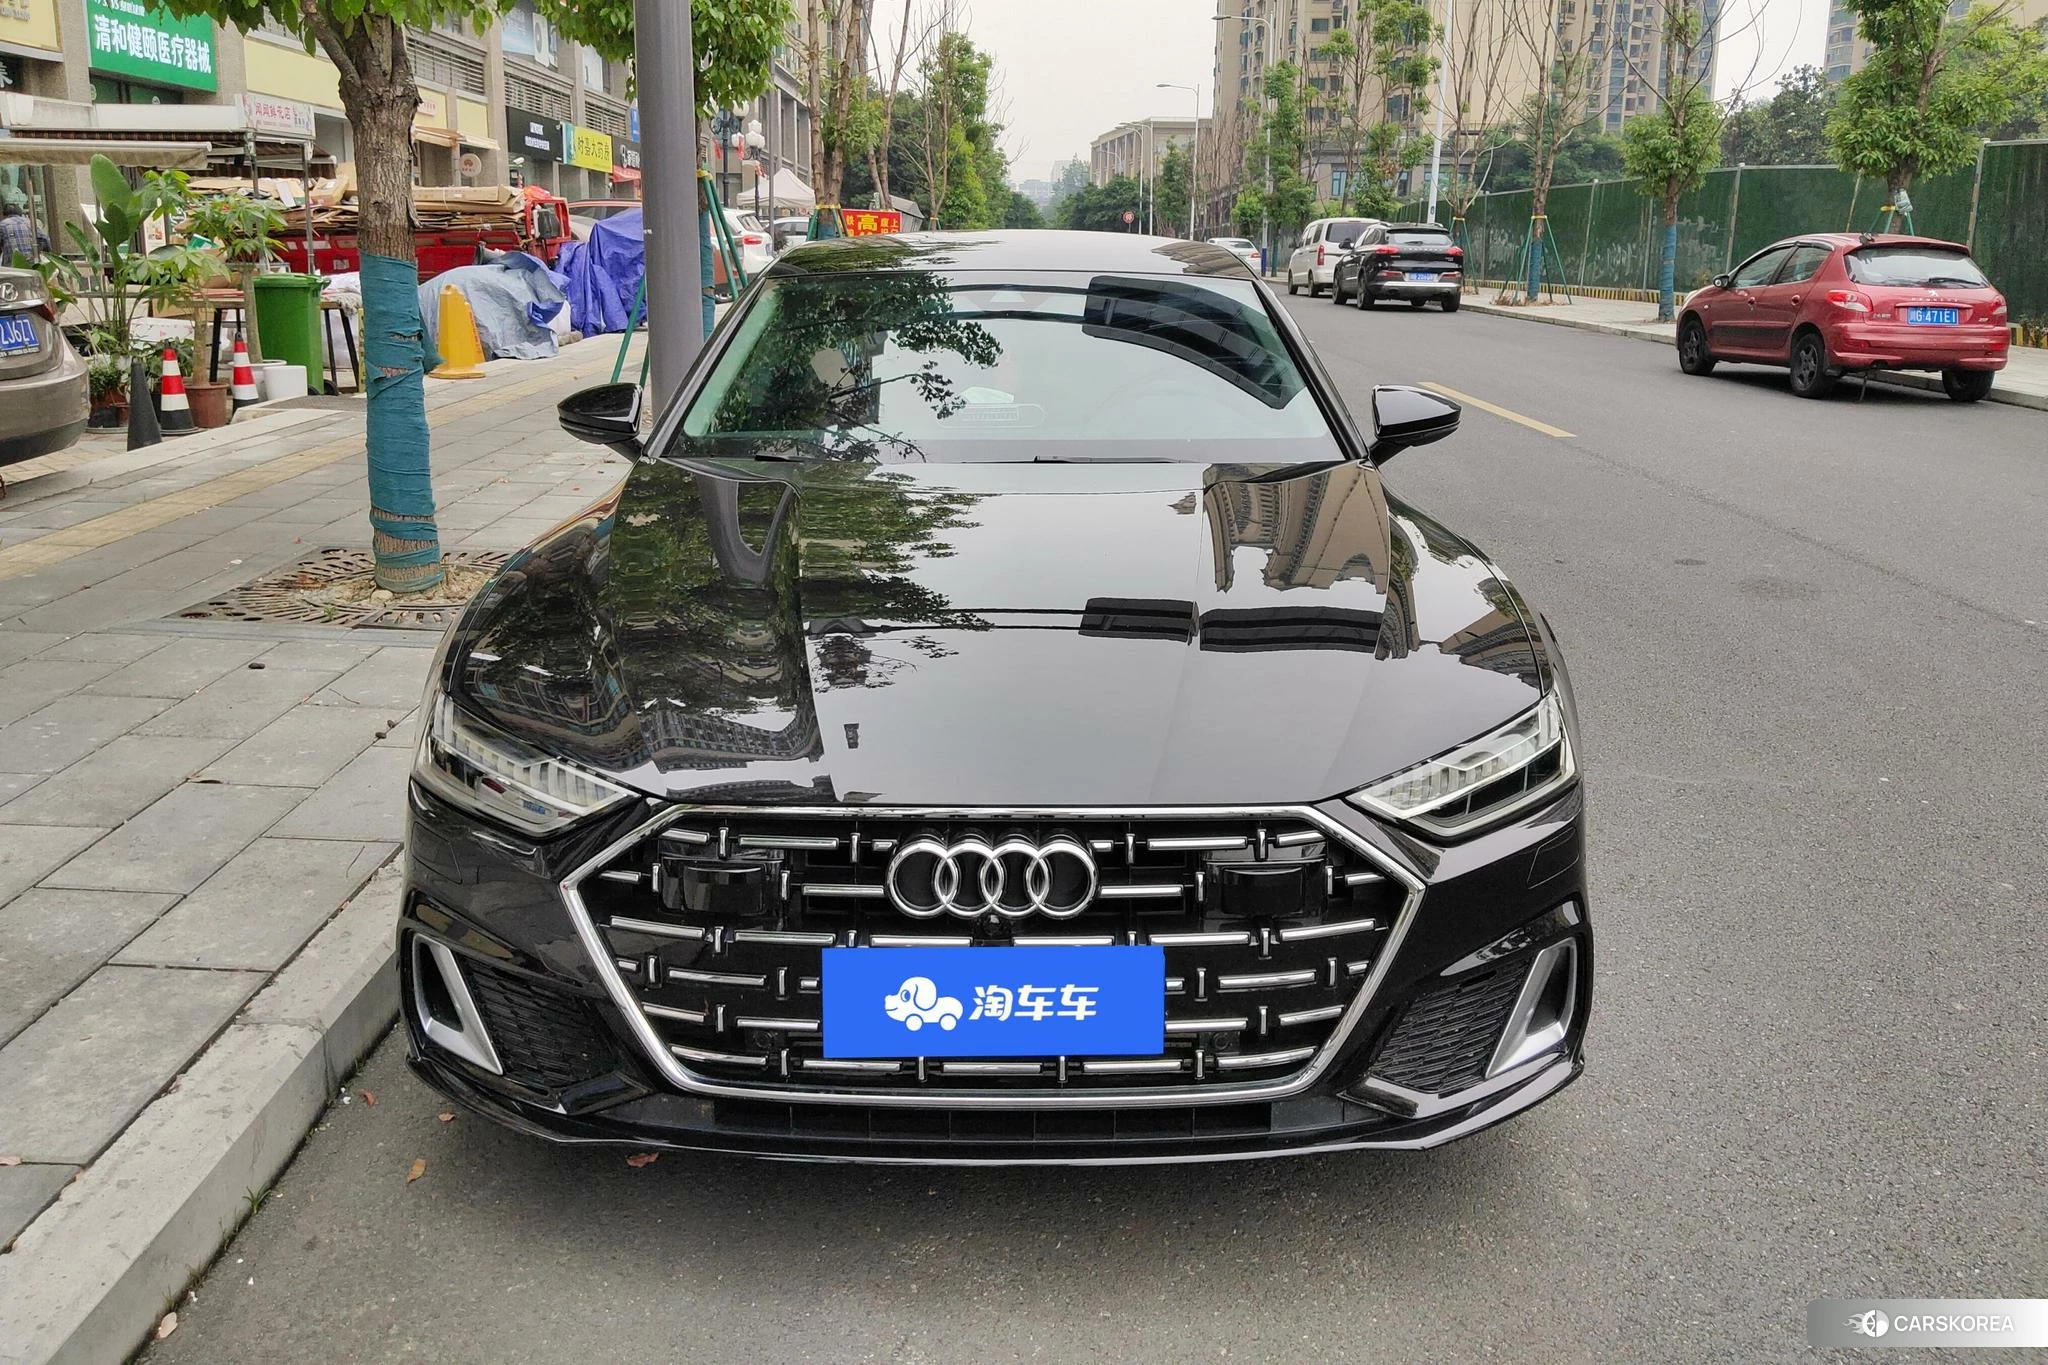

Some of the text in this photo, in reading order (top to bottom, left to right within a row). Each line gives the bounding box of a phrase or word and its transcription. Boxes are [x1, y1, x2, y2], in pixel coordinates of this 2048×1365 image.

[94, 14, 211, 74] 清和健颐医疗器械
[857, 214, 878, 231] 高
